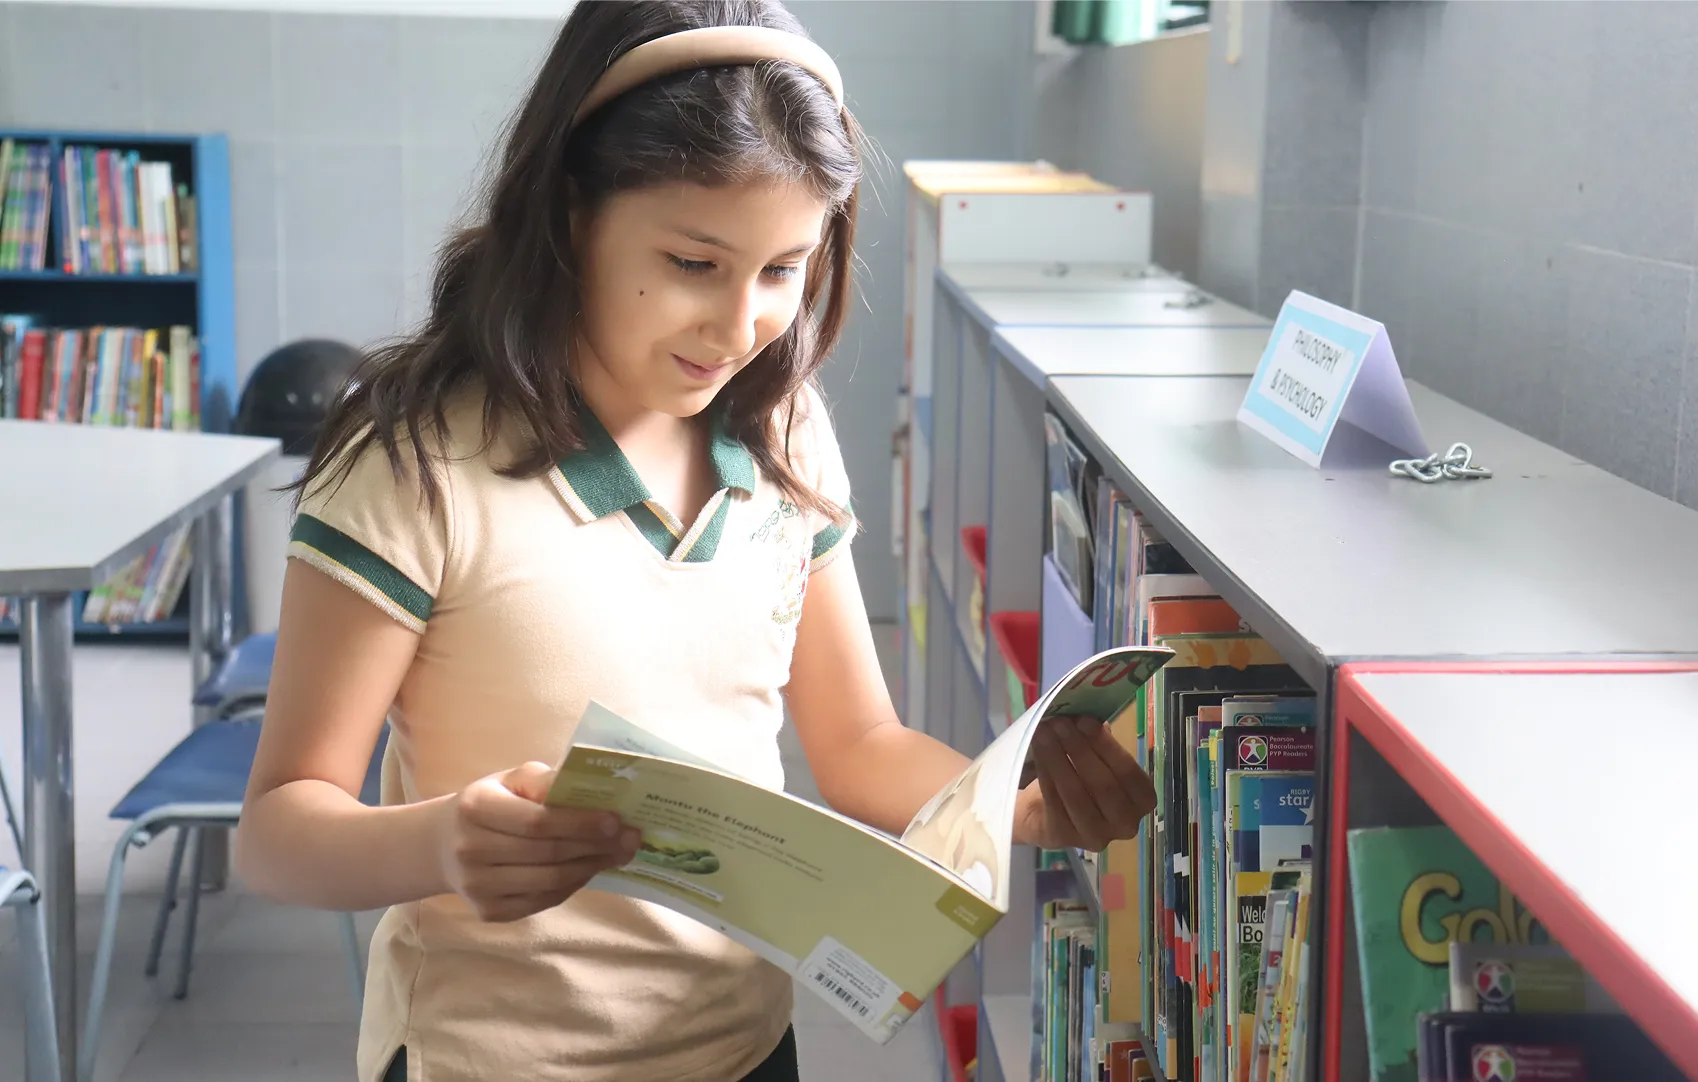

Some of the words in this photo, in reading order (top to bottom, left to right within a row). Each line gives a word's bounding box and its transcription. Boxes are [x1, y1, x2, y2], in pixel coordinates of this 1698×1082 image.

[1292, 330, 1342, 374] PHILOSOPHY
[1270, 368, 1282, 389] &
[1278, 373, 1328, 421] PSYCHOLOGY
[1279, 794, 1310, 806] star
[698, 806, 721, 819] the
[723, 815, 786, 845] Elephant
[1243, 926, 1263, 942] Bo
